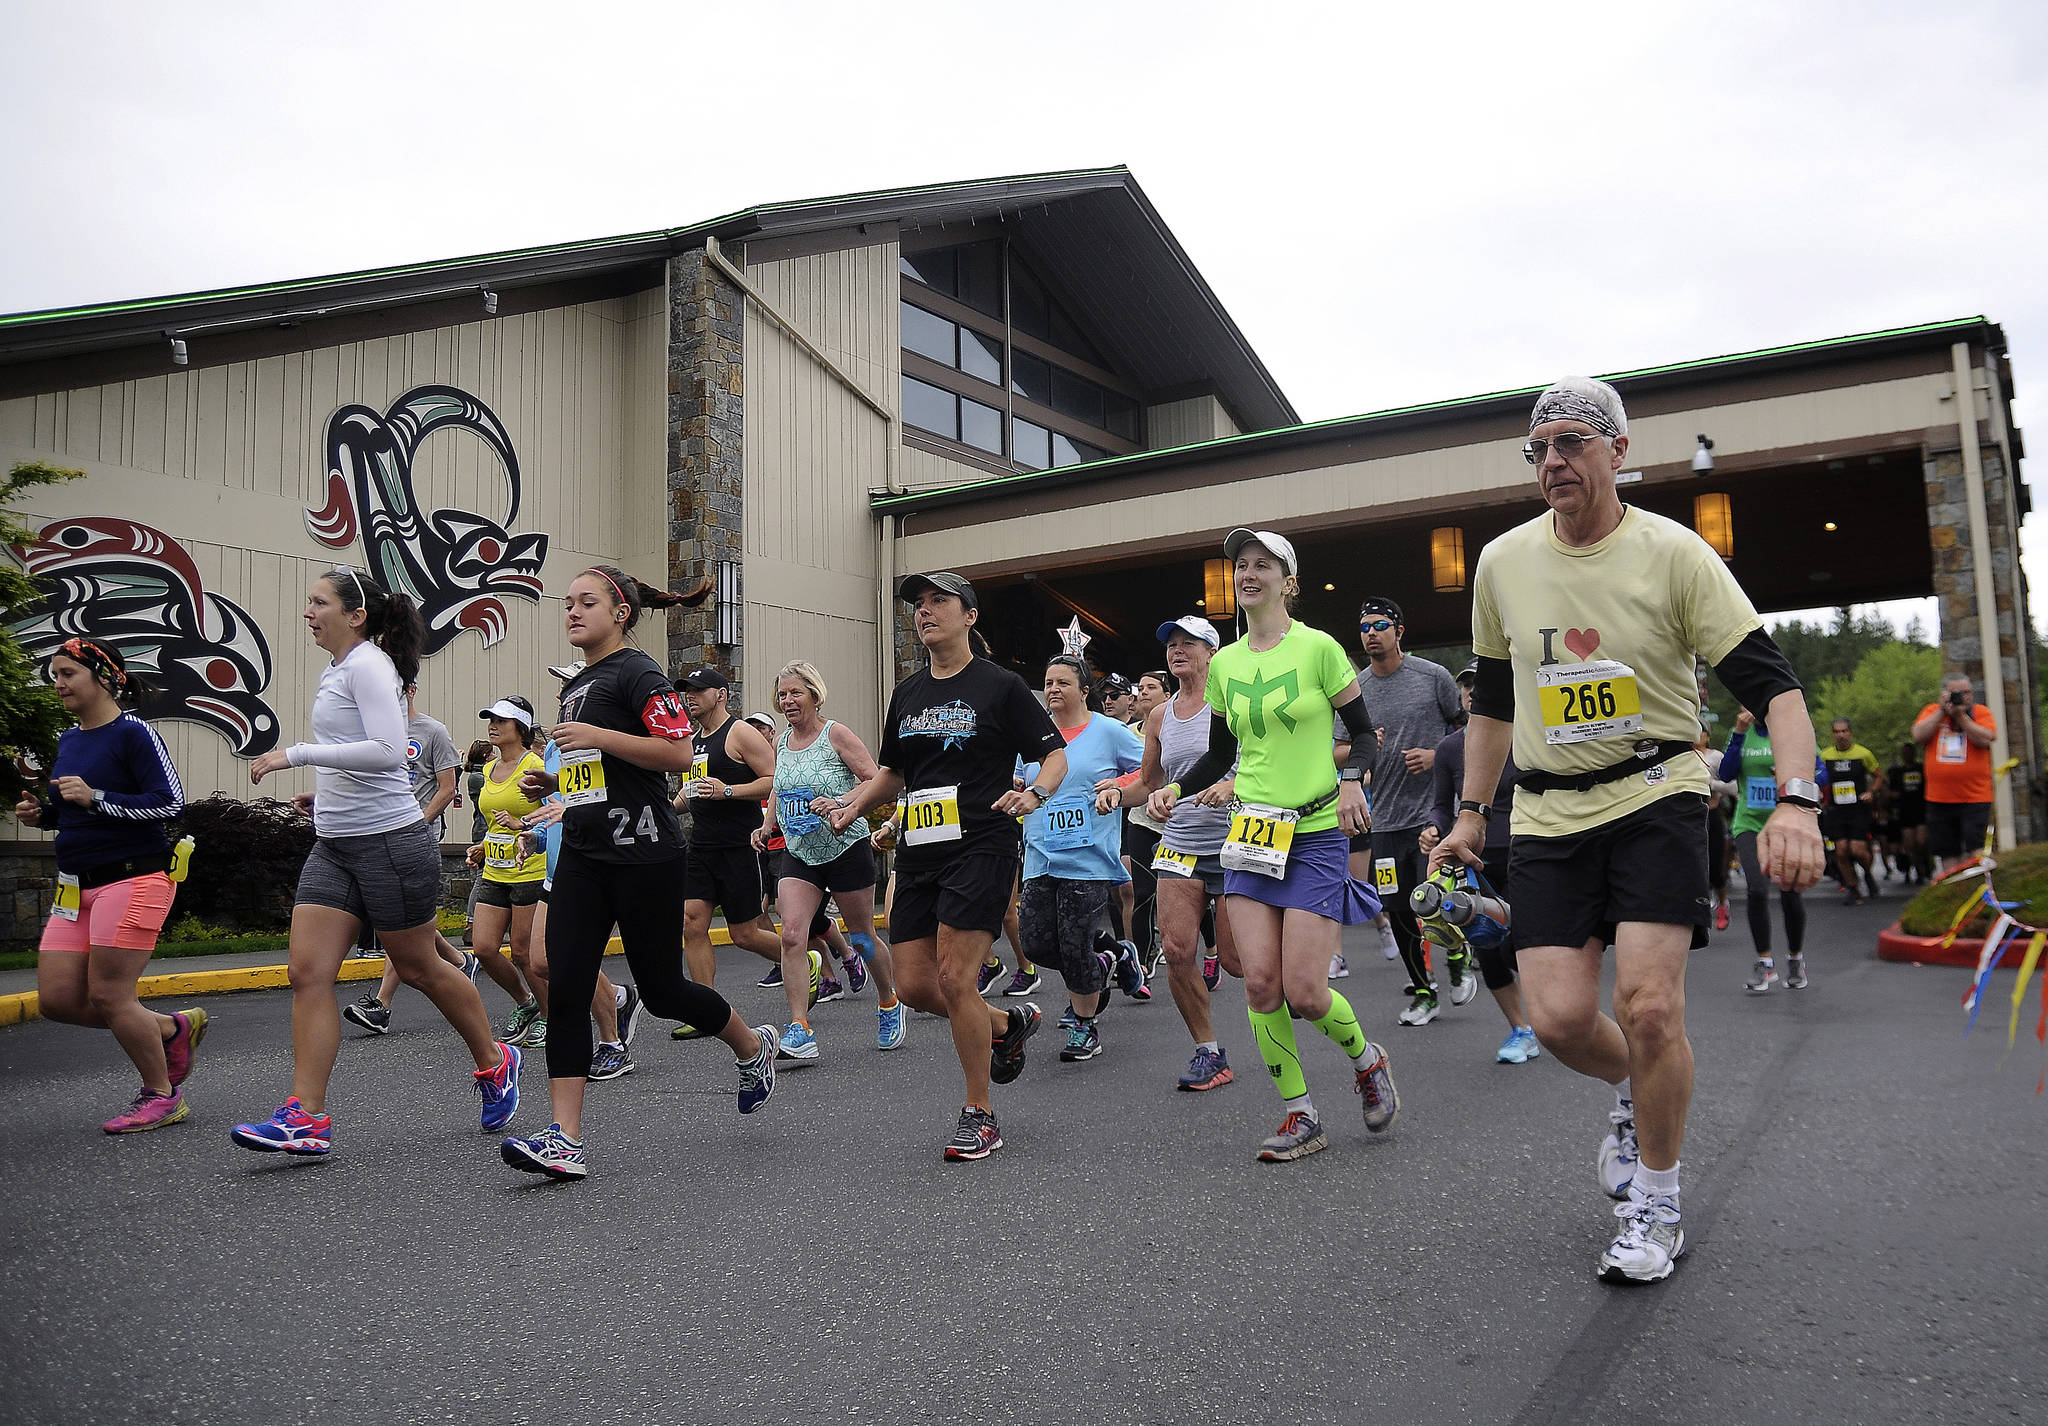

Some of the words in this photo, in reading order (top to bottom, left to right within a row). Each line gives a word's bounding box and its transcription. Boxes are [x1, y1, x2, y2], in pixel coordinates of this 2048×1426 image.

[1539, 628, 1559, 666] I
[1559, 681, 1617, 724] 266
[566, 763, 592, 793] 249
[784, 798, 810, 818] 7019
[914, 801, 945, 829] 103
[1048, 809, 1084, 830] 7029
[608, 805, 659, 846] 24
[1238, 817, 1276, 848] 121
[488, 842, 505, 859] 176
[1378, 868, 1393, 885] 25
